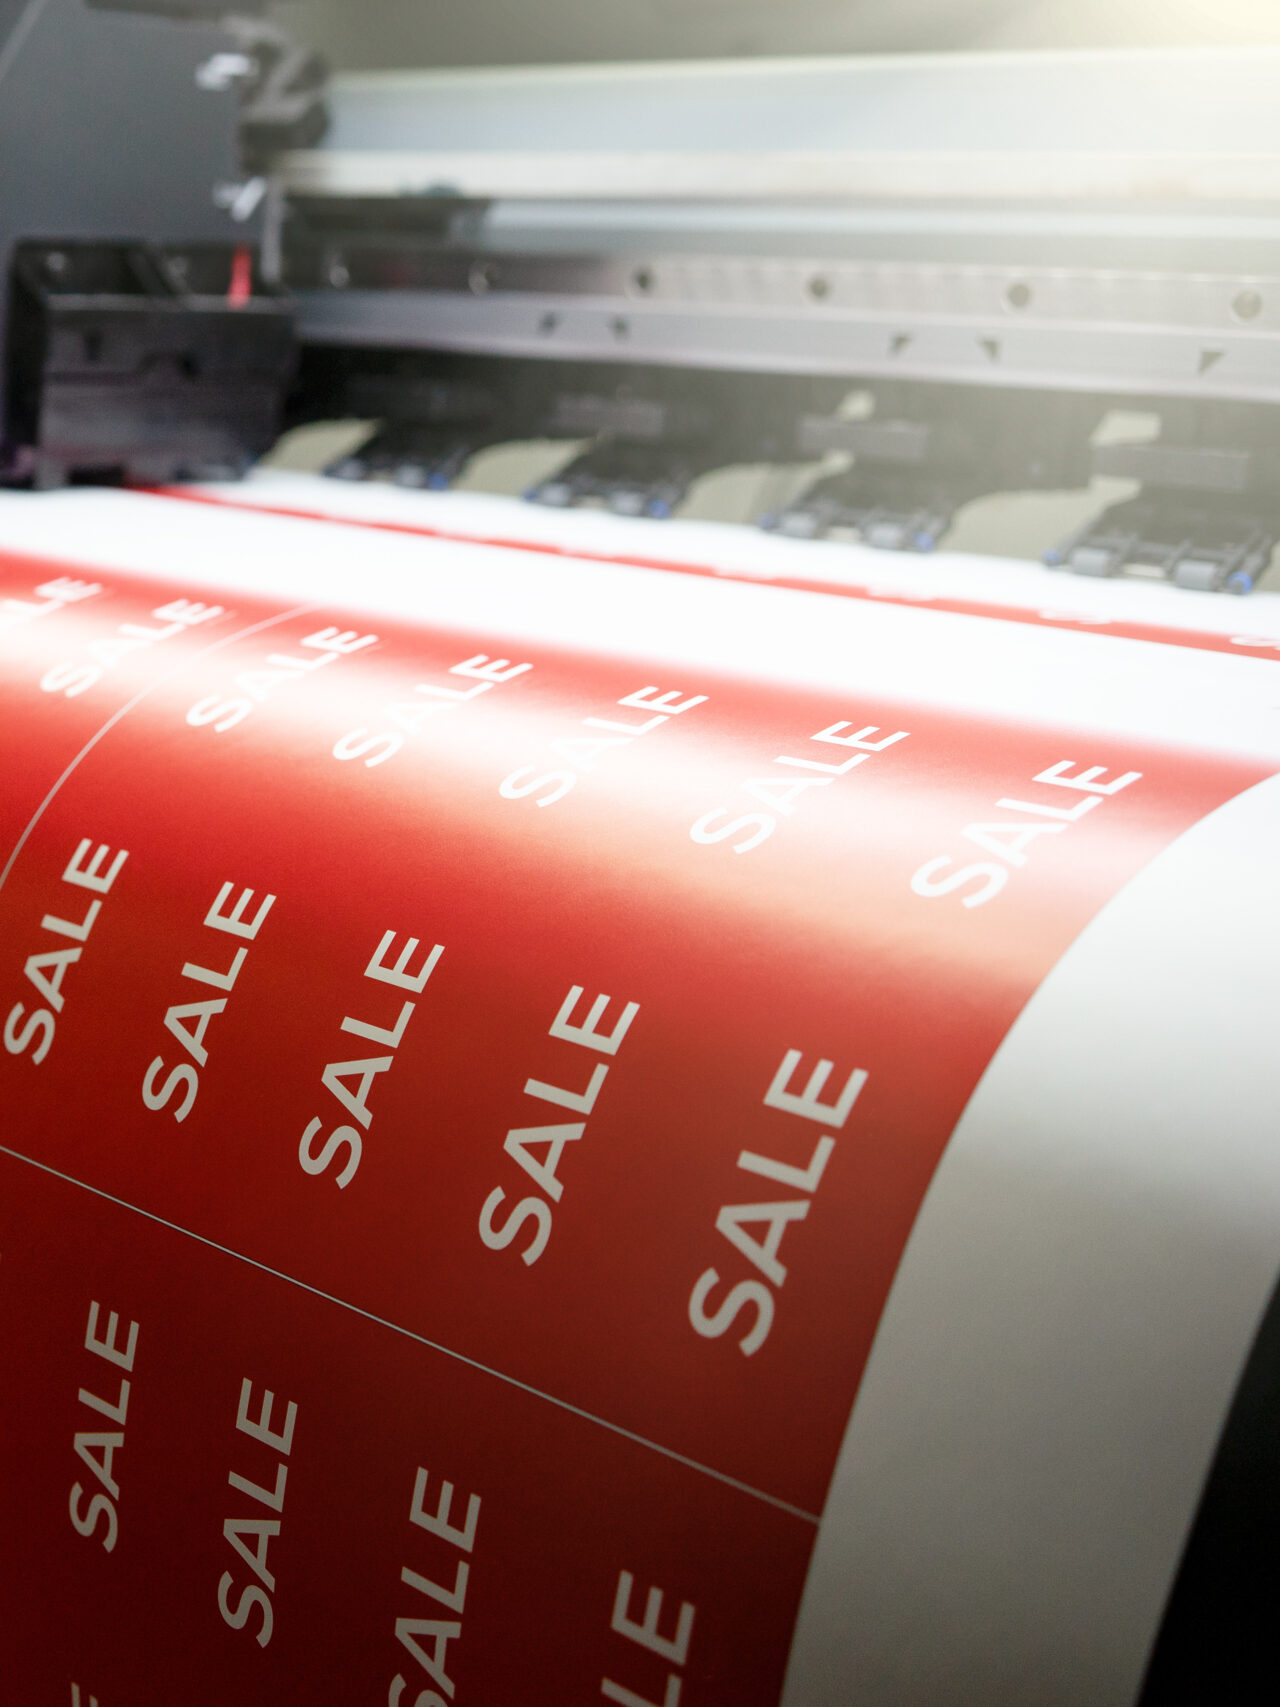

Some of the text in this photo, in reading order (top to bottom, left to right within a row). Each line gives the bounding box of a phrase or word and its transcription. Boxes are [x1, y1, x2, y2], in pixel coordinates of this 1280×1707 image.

[39, 598, 226, 698] SALE
[185, 626, 379, 733] SALE
[332, 654, 534, 767] SALE
[498, 686, 709, 808] SALE
[689, 720, 910, 855] SALE
[910, 759, 1143, 909] SALE
[3, 838, 130, 1065] SALE
[141, 880, 277, 1123] SALE
[298, 929, 445, 1189] SALE
[478, 984, 641, 1267] SALE
[688, 1049, 869, 1358] SALE
[68, 1300, 139, 1554] SALE
[217, 1377, 298, 1649] SALE
